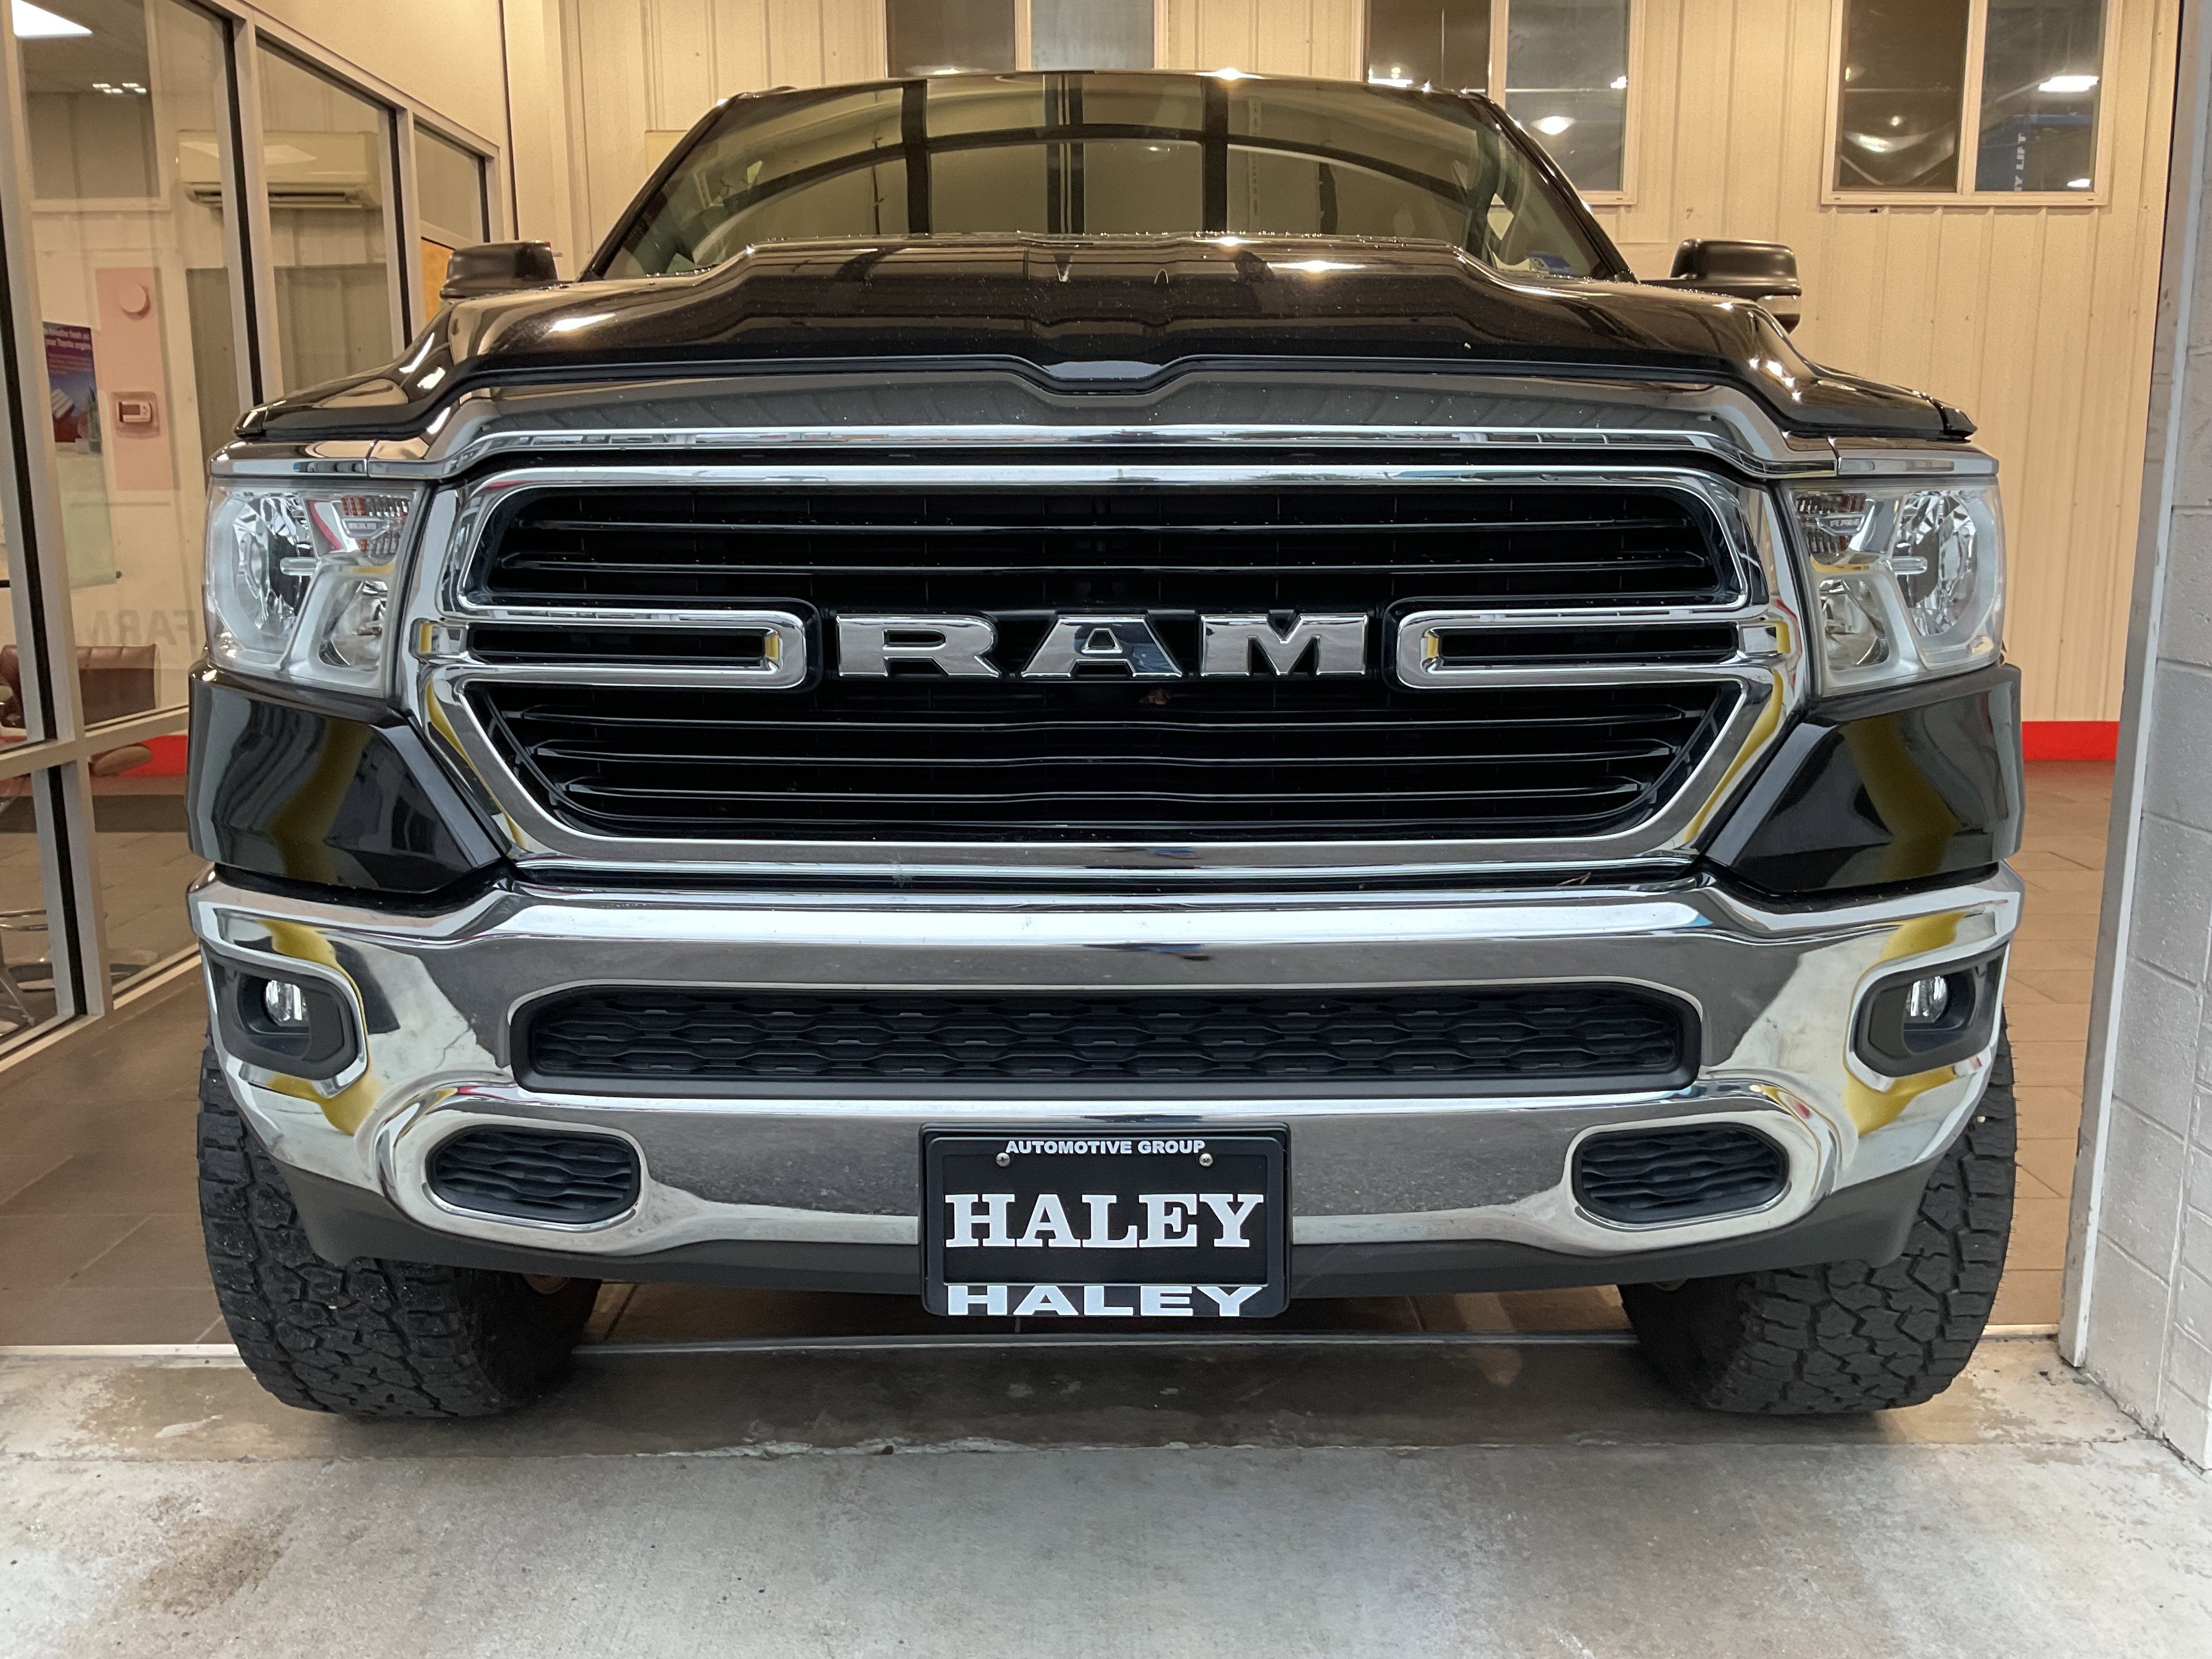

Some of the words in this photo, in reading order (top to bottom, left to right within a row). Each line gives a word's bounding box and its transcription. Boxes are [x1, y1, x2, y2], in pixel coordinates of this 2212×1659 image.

[2016, 133, 2025, 170] LIFT
[836, 613, 1368, 678] RAM
[1005, 1140, 1132, 1154] AUTOMOTIVE
[1137, 1140, 1206, 1154] GROUP
[945, 1193, 1263, 1248] HALEY
[947, 1285, 1262, 1317] HALEY
